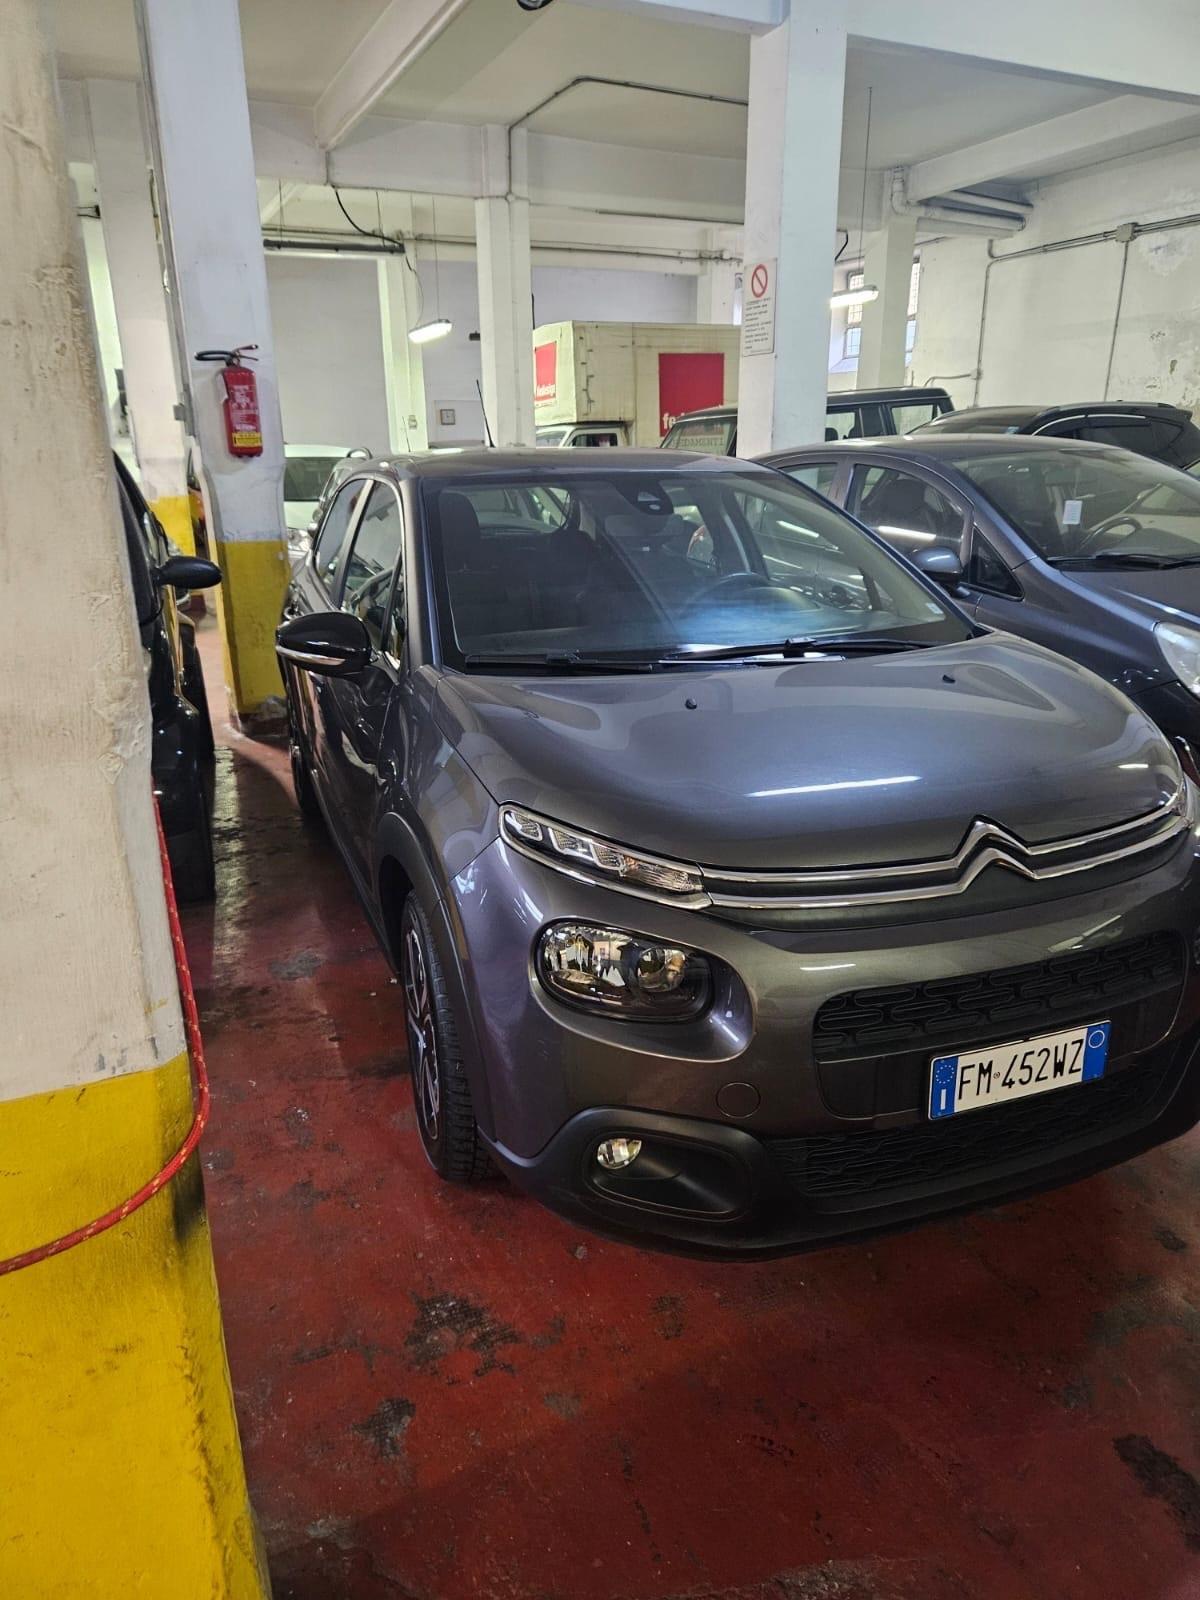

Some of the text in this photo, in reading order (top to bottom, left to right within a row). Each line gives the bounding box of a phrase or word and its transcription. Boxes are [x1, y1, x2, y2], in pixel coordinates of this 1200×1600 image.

[958, 1038, 1084, 1100] FM 452WZ
[940, 1088, 947, 1110] I
